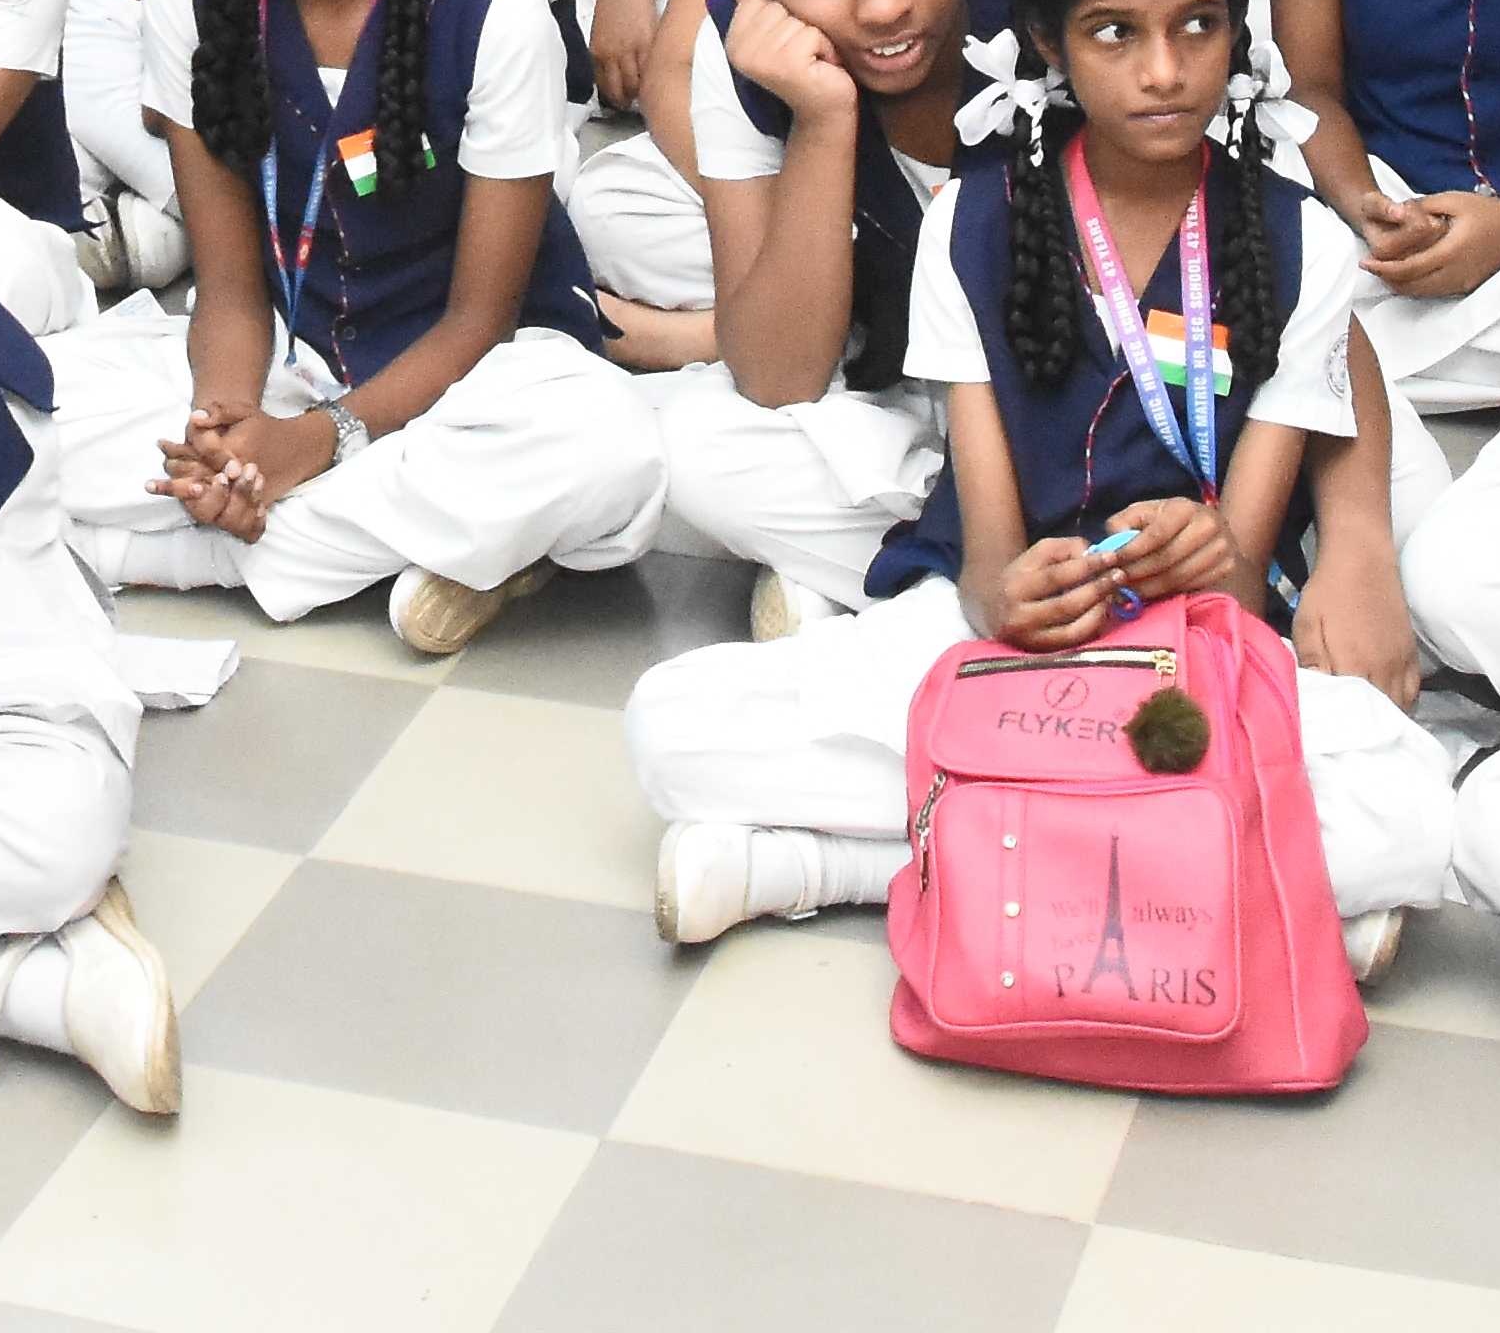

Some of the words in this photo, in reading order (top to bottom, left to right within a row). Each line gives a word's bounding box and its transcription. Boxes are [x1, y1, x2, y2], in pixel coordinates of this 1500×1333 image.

[1086, 217, 1109, 260] YEARS
[1187, 232, 1200, 249] 42
[1101, 260, 1116, 277] 42
[997, 710, 1118, 744] FLYKER
[1131, 899, 1213, 931] always
